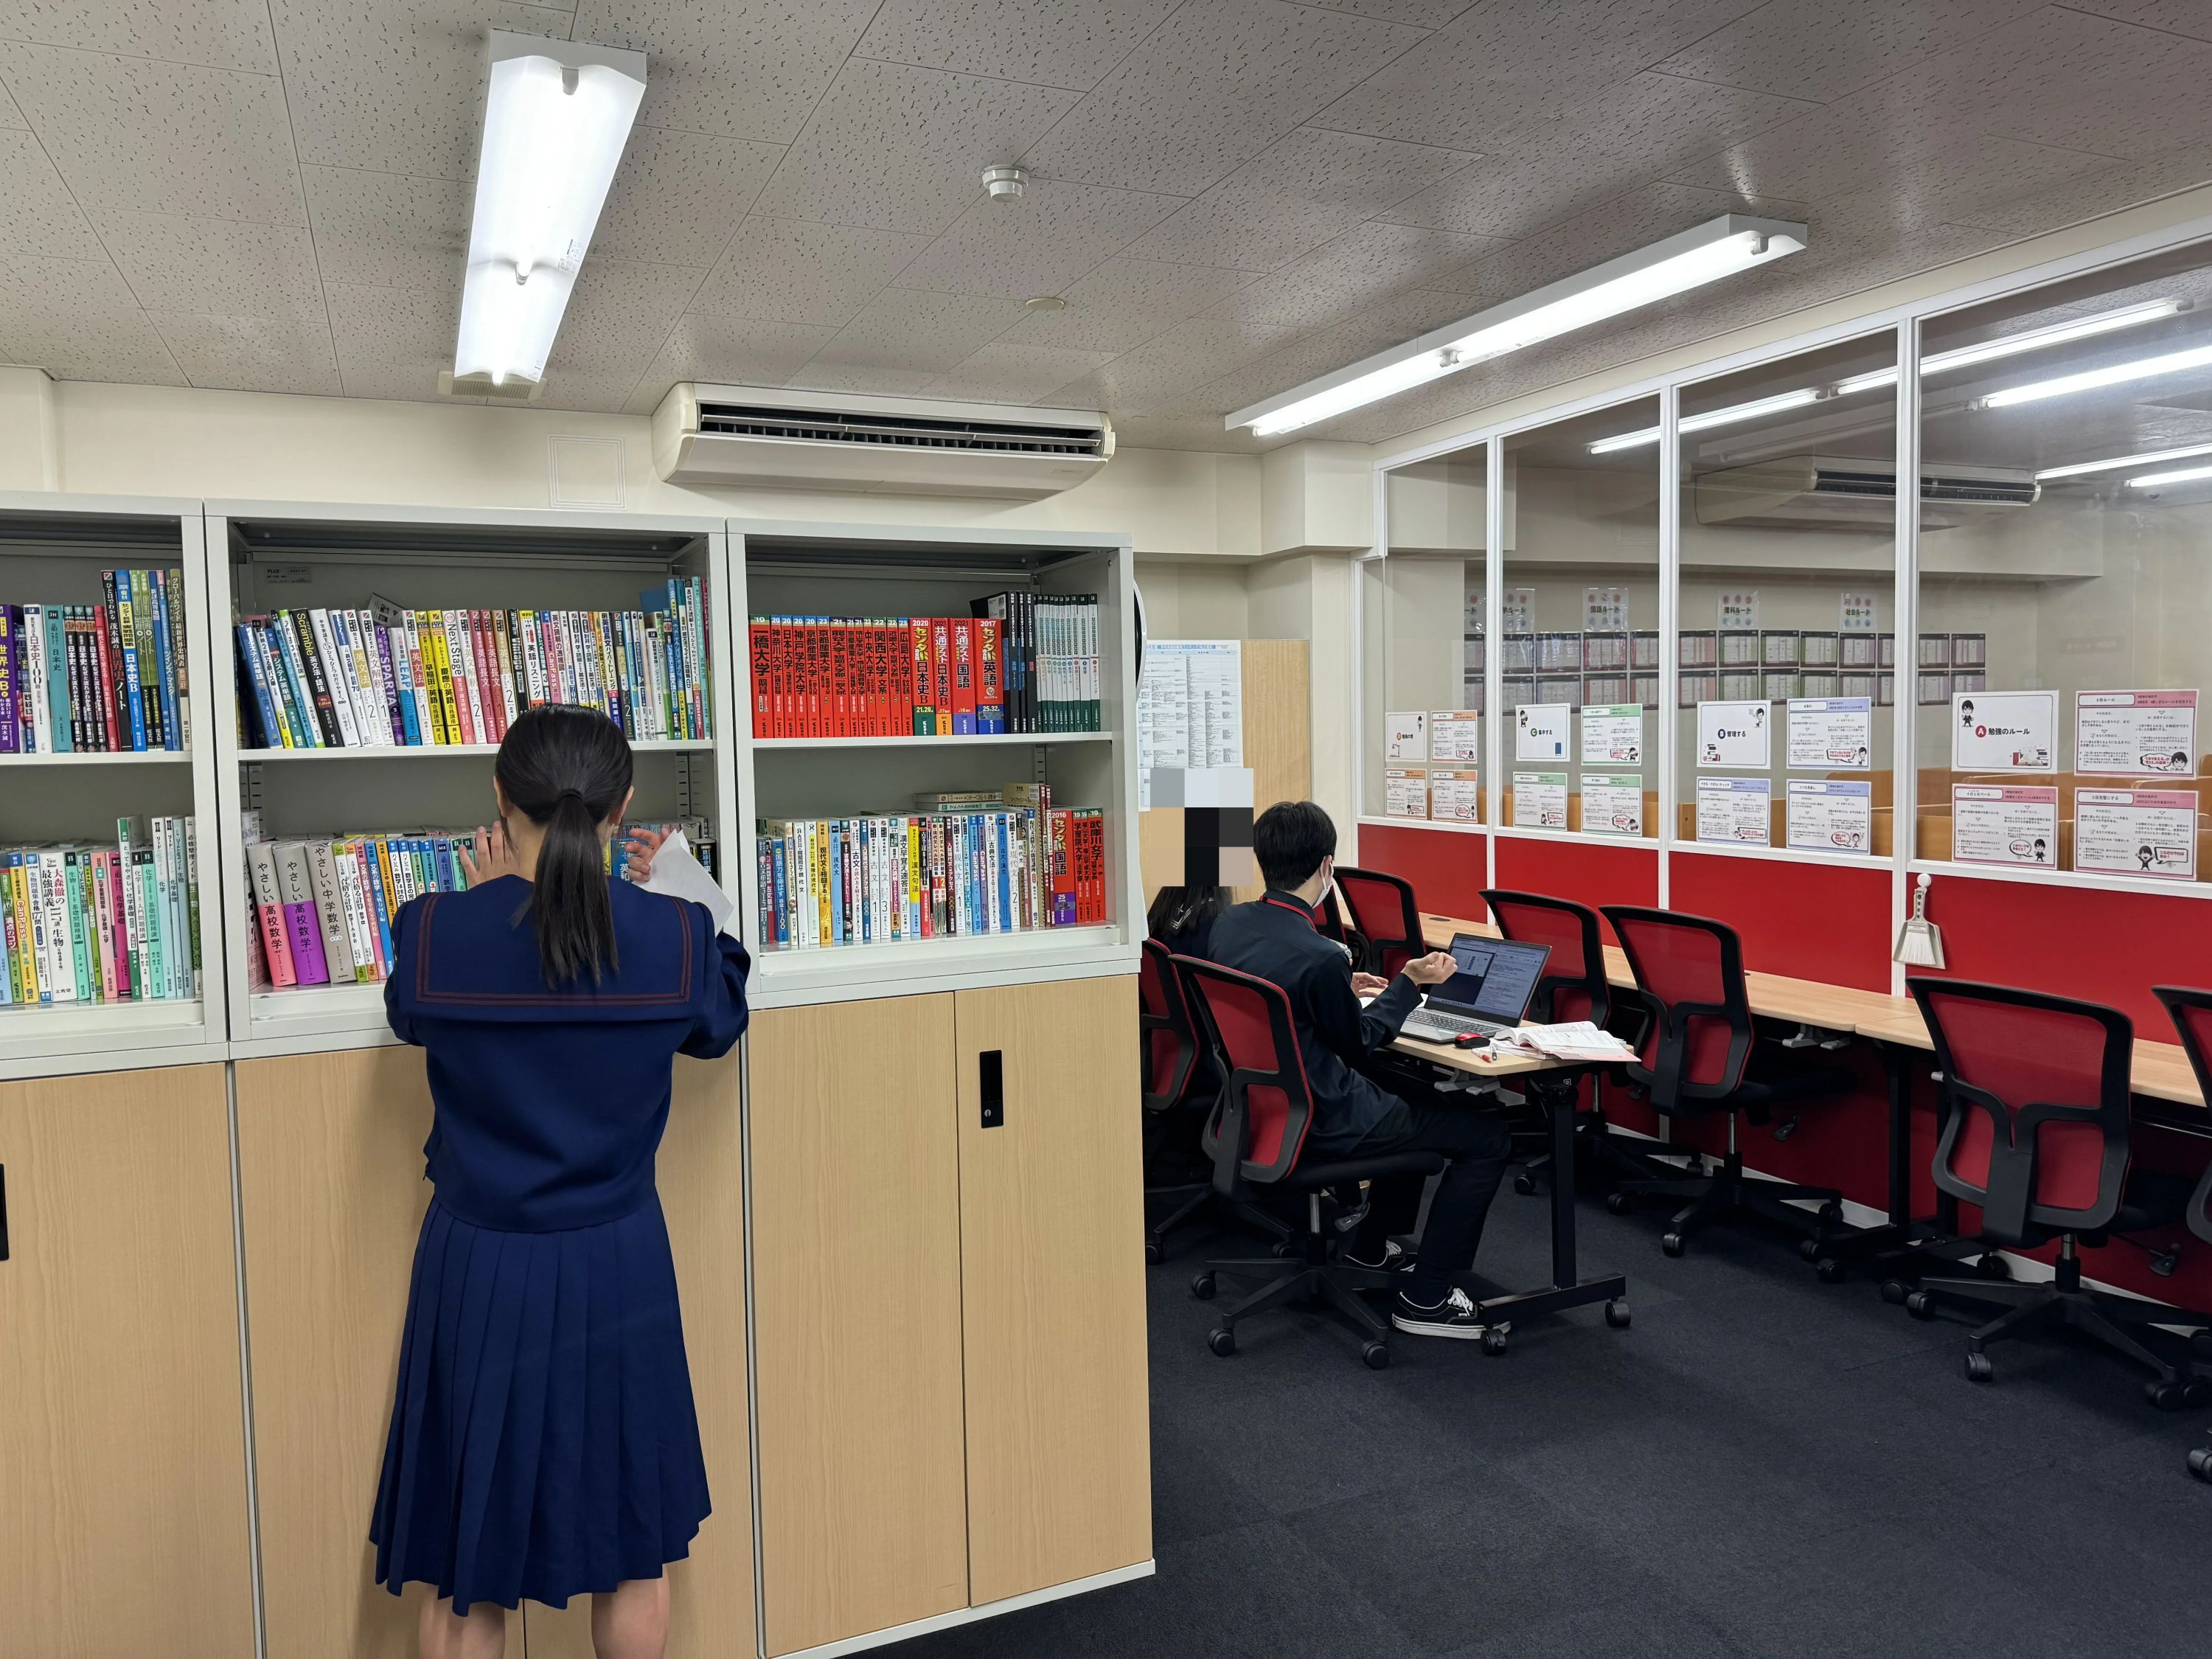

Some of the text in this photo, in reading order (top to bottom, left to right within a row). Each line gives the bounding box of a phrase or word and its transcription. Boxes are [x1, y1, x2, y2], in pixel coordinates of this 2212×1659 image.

[106, 582, 116, 620] ひと目でわかる
[173, 578, 181, 622] グローバルワイド
[110, 623, 119, 649] 茂木誠の
[297, 613, 313, 655] Scramble
[447, 624, 462, 675] Next Stage
[772, 630, 782, 672] 神奈川大学
[783, 630, 793, 669] 日本大学
[818, 630, 830, 672] 京都産業大学
[935, 626, 947, 664] 共通テスト
[955, 625, 969, 663] 共通テスト
[52, 649, 61, 671] 日本史
[79, 646, 88, 665] 日本史
[90, 646, 98, 666] 日本史
[355, 653, 369, 685] 英文法
[369, 650, 383, 688] 英文解釈
[411, 653, 424, 684] 英文法
[477, 650, 490, 687] 英語長文
[488, 650, 501, 687] 英語長文
[548, 653, 557, 687] CanPass
[753, 630, 771, 676] 一橋大学
[794, 630, 805, 695] 神戸学院大学
[807, 630, 817, 677] 京都産業大学
[864, 630, 874, 677] 中央大学
[874, 630, 887, 677] 関西大学
[900, 630, 910, 677] 広島大学
[126, 654, 138, 692] 日本史B
[274, 658, 292, 701] システム英単語
[310, 655, 325, 692] 英文法・語法
[380, 657, 397, 706] SPARTA
[399, 660, 411, 688] LEAP
[528, 645, 541, 698] 英語リスニング
[543, 673, 548, 683] 3
[878, 679, 888, 694] 文系
[917, 662, 929, 704] 日本史B
[937, 664, 949, 706] 日本史B
[957, 664, 970, 689] 国語
[983, 661, 997, 686] 英語
[116, 682, 126, 710] ノート
[367, 705, 376, 718] 2
[380, 705, 386, 717] 1
[420, 704, 426, 717] 1
[473, 704, 481, 717] 2
[506, 689, 514, 703] 2
[625, 705, 632, 717] 2
[1988, 728, 2030, 736] 勉強のルール
[1074, 822, 1082, 862] 学習院大学
[69, 872, 76, 883] 生物
[135, 871, 141, 883] 化学
[145, 869, 153, 881] 化学
[360, 863, 370, 891] 文系の数学
[370, 863, 380, 891] 文系の数学
[620, 863, 630, 881] 英和
[819, 847, 828, 894] 現代文と格闘する
[871, 860, 878, 882] 古文
[881, 860, 888, 882] 古文
[900, 835, 908, 895] 漢文早覚え速答法
[1054, 852, 1067, 875] 国語
[42, 870, 55, 907] 最強講義
[54, 869, 65, 905] 大森徹の
[124, 846, 134, 917] とってもやさしい化学基礎
[159, 881, 165, 893] 化学
[315, 847, 340, 935] やさしい中学数学
[935, 877, 939, 887] 1
[940, 877, 945, 887] 2
[1012, 892, 1018, 904] 2
[257, 863, 282, 950] やさしい高校数学
[287, 861, 311, 949] やさしい高校数学
[872, 902, 877, 912] 1
[882, 901, 888, 913] 3
[957, 896, 961, 908] 1
[72, 904, 81, 939] 基礎問題精講
[138, 904, 146, 939] 入門問題精講
[149, 902, 157, 938] 基礎問題精講
[52, 928, 64, 947] 生物
